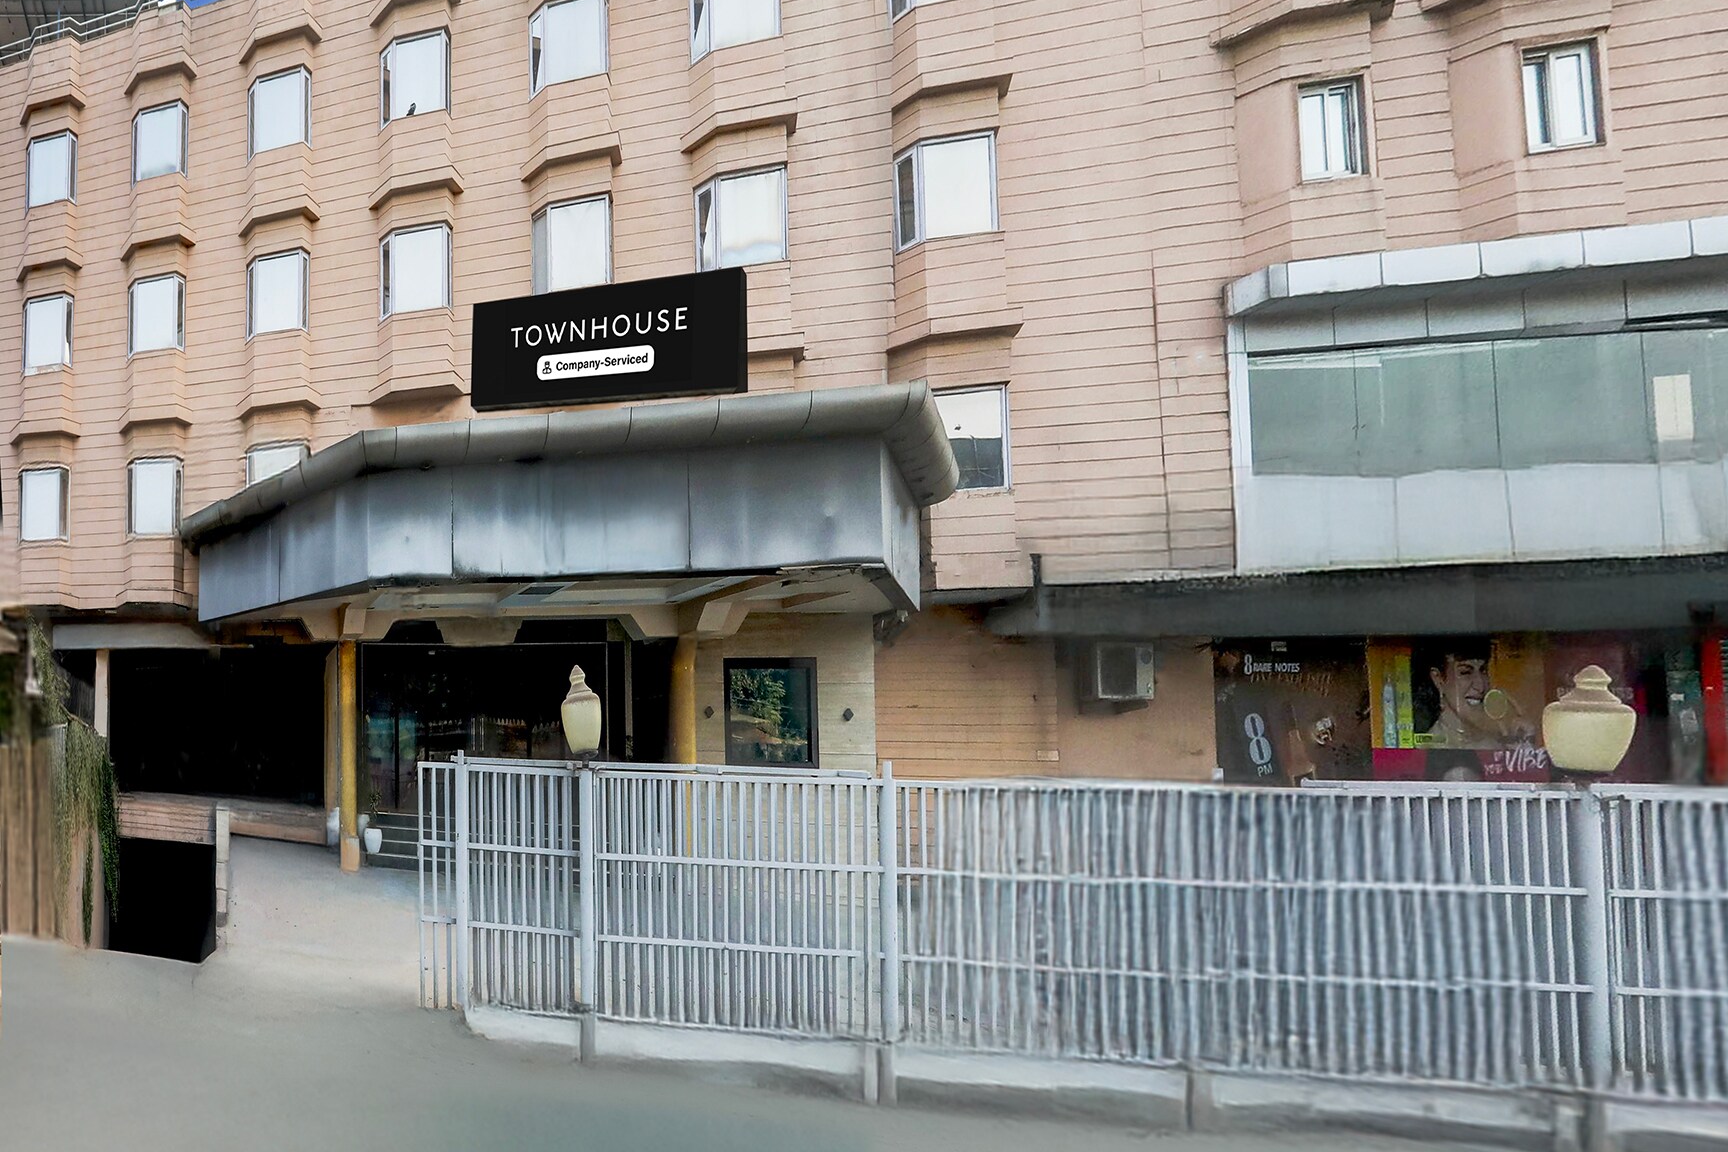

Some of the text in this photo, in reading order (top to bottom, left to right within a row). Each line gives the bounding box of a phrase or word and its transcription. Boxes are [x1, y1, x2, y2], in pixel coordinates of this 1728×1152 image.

[510, 306, 688, 349] TOWNHOUSE
[555, 352, 649, 373] Company-Serviced
[1244, 654, 1300, 675] 8 RARE NOTES
[1244, 713, 1272, 765] 8
[1257, 764, 1273, 777] PM
